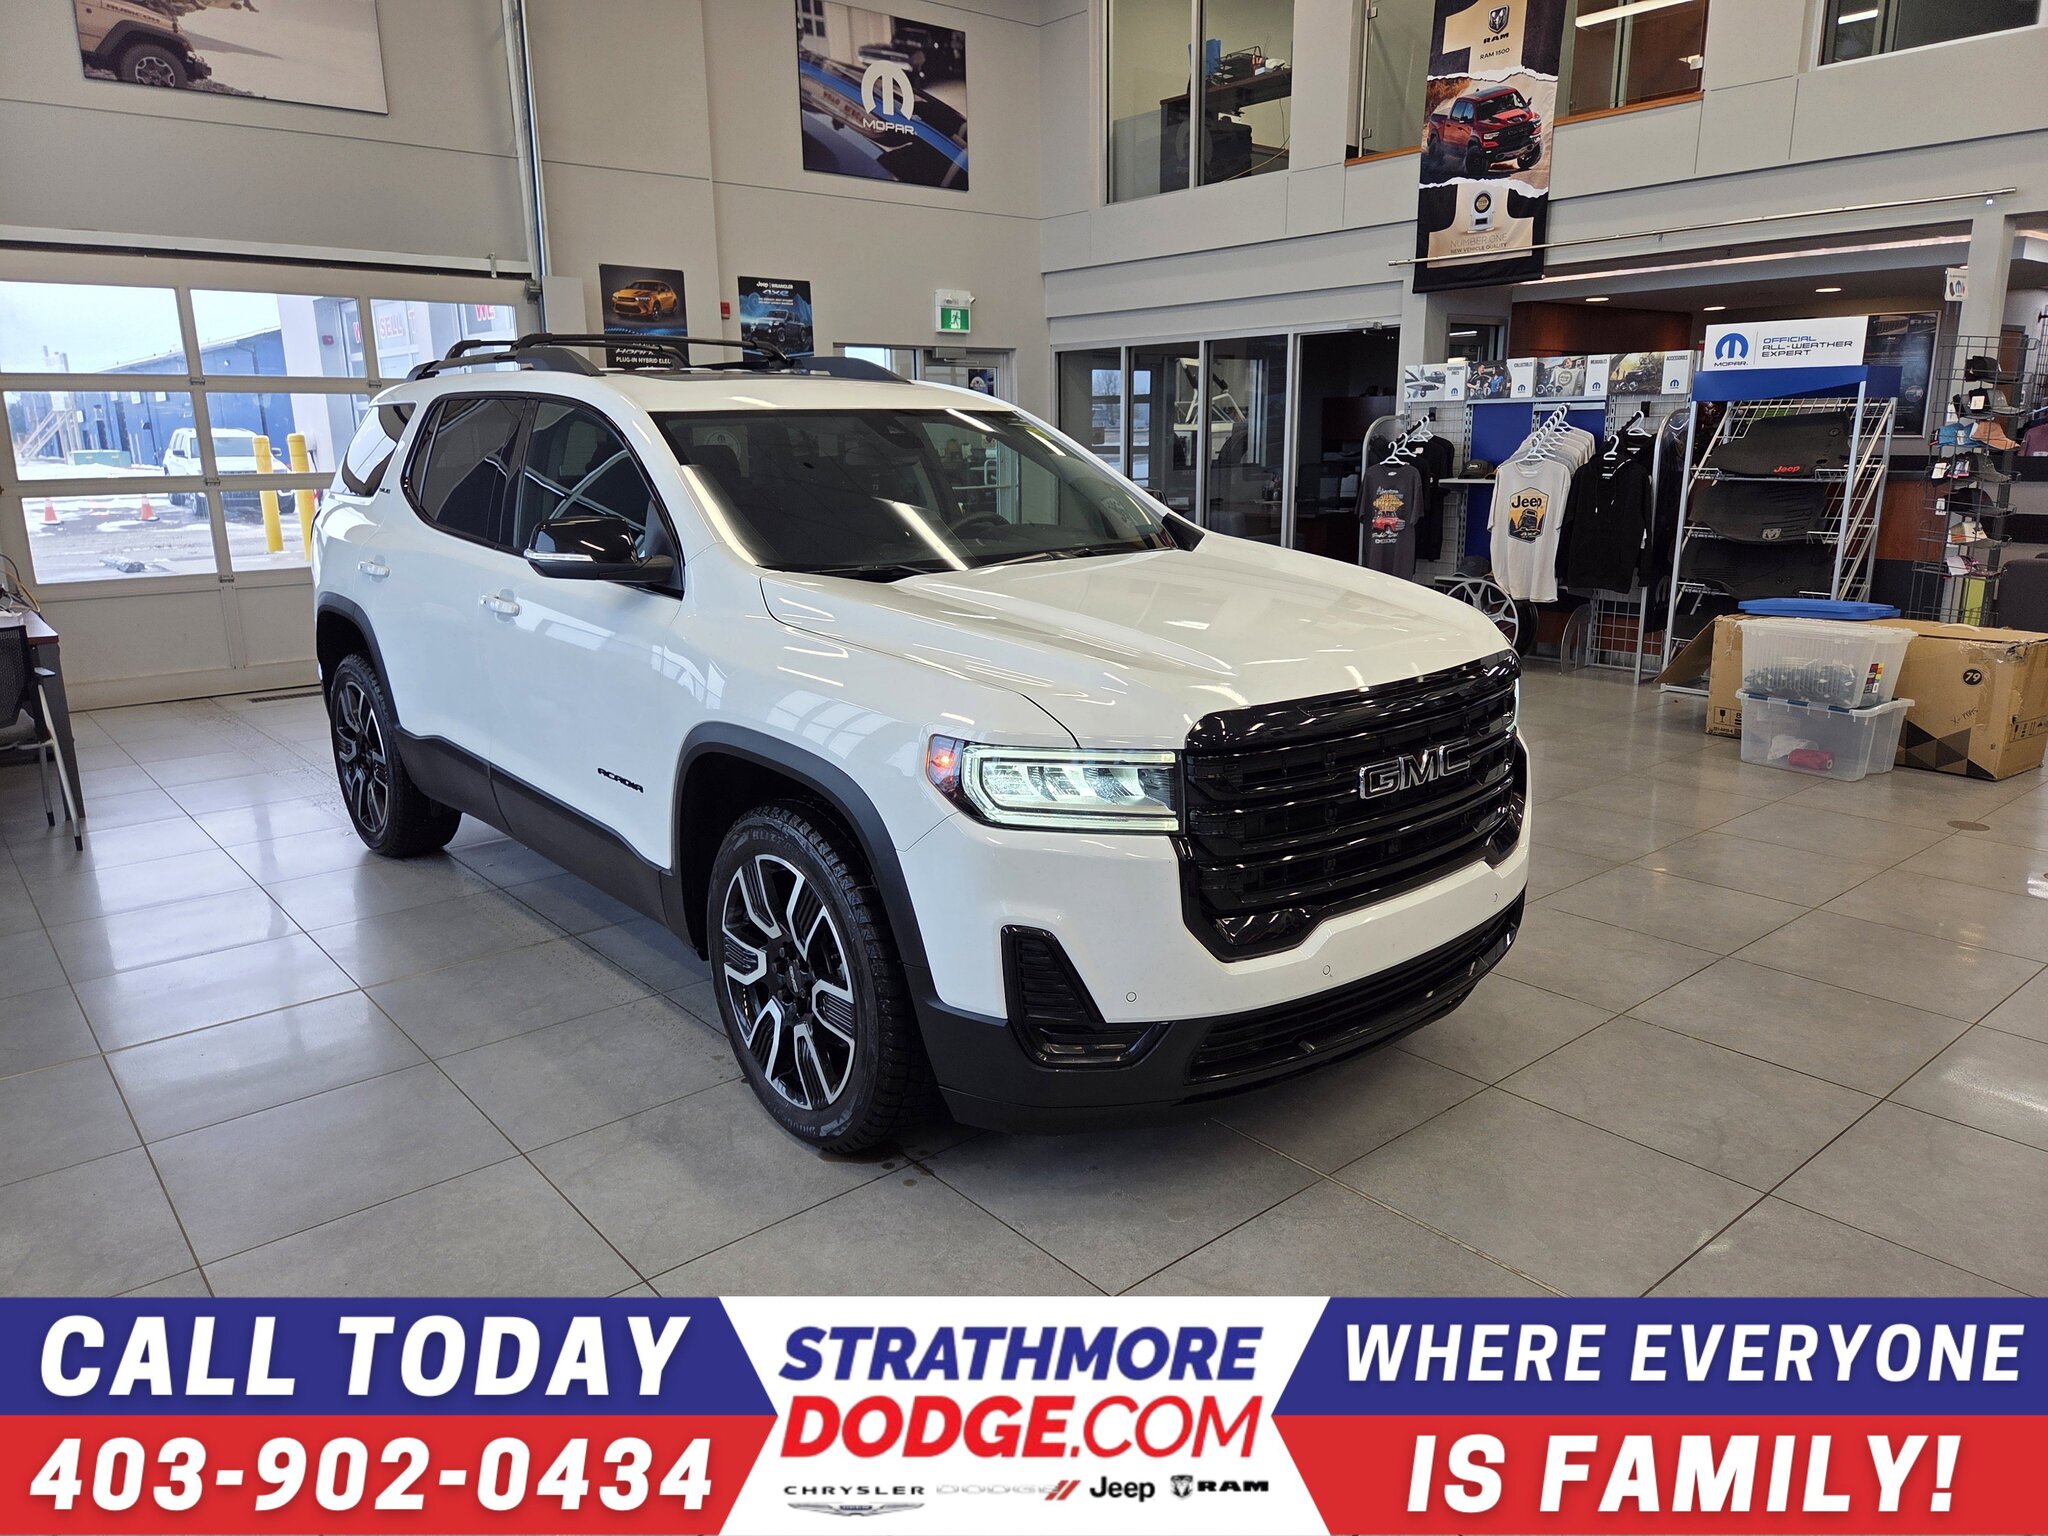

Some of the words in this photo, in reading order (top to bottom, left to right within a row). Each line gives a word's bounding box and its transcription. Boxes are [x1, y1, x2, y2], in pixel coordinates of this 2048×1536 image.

[1483, 32, 1510, 44] RAM
[1480, 52, 1495, 60] RAM
[1495, 47, 1511, 56] 1500
[1450, 236, 1488, 248] NUMBER
[1489, 232, 1508, 243] ONE
[1486, 242, 1508, 250] QUALITY
[1763, 335, 1817, 344] OFFICIAL
[1762, 340, 1854, 351] ALL-WEATHER
[1761, 349, 1812, 357] EXPERT
[615, 356, 637, 364] PLUG-IN
[1773, 465, 1801, 473] Jeep
[1511, 495, 1543, 509] Jeep
[1965, 672, 1981, 682] 79
[1359, 738, 1471, 800] GMC
[597, 767, 644, 794] ACADIA
